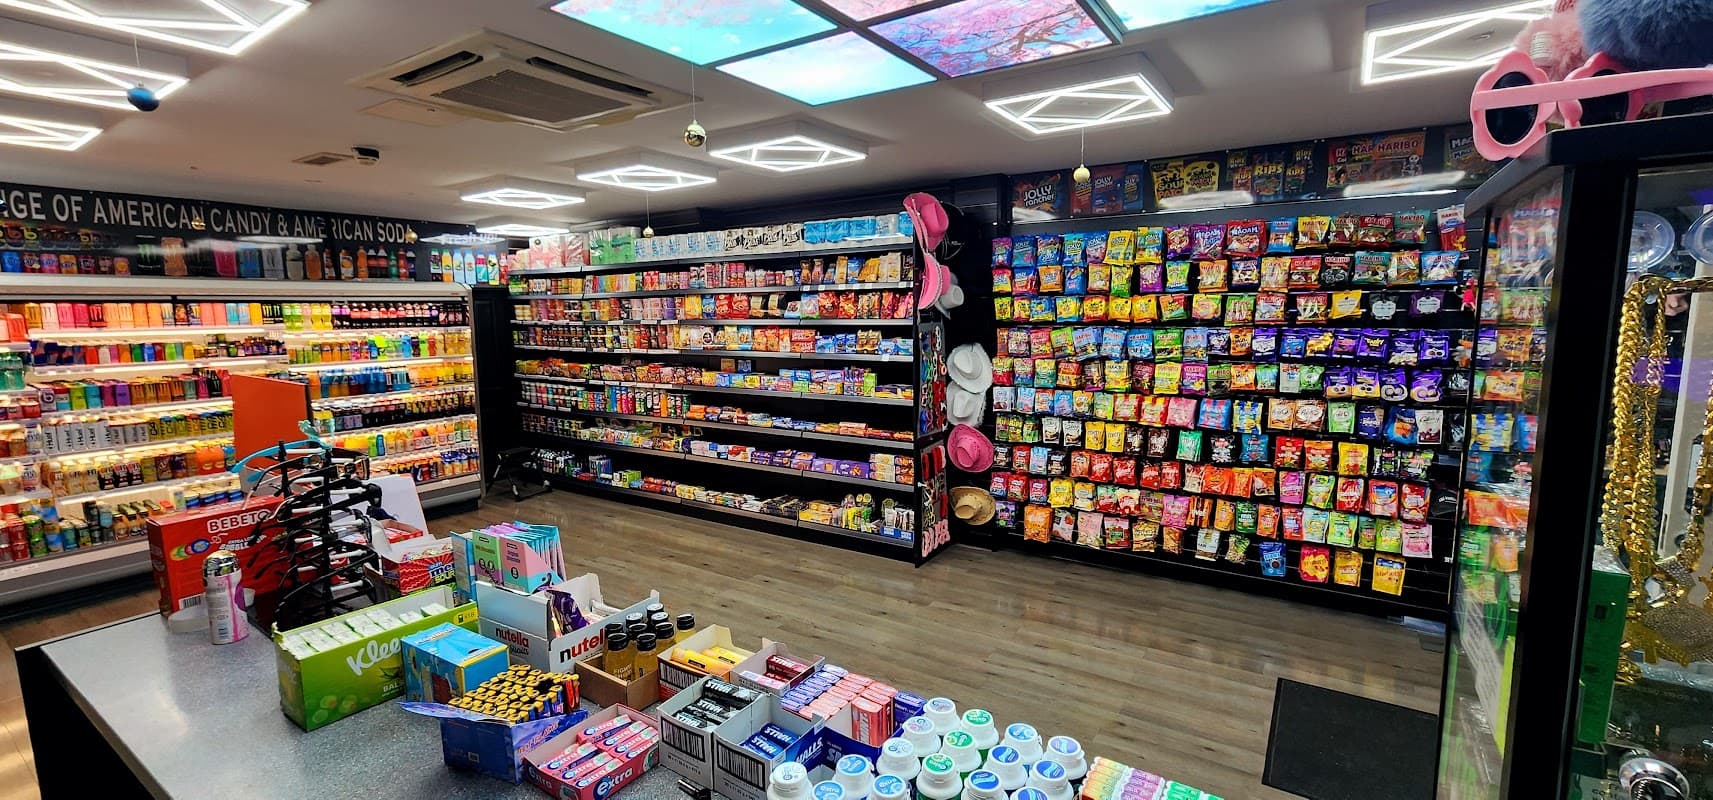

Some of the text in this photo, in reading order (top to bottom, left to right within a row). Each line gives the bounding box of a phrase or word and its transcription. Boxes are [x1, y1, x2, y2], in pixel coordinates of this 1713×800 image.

[1377, 139, 1419, 153] HARIBO
[1024, 184, 1052, 202] JOLLY
[1026, 194, 1055, 207] rancher
[52, 194, 83, 223] OF
[94, 197, 205, 230] AMERICAN
[210, 208, 271, 235] CANDY
[277, 213, 289, 237] &
[1230, 225, 1259, 237] MAOAM
[495, 626, 529, 648] nutella
[763, 726, 793, 743] HALLS
[751, 736, 778, 754] HALLS
[594, 767, 633, 797] extra
